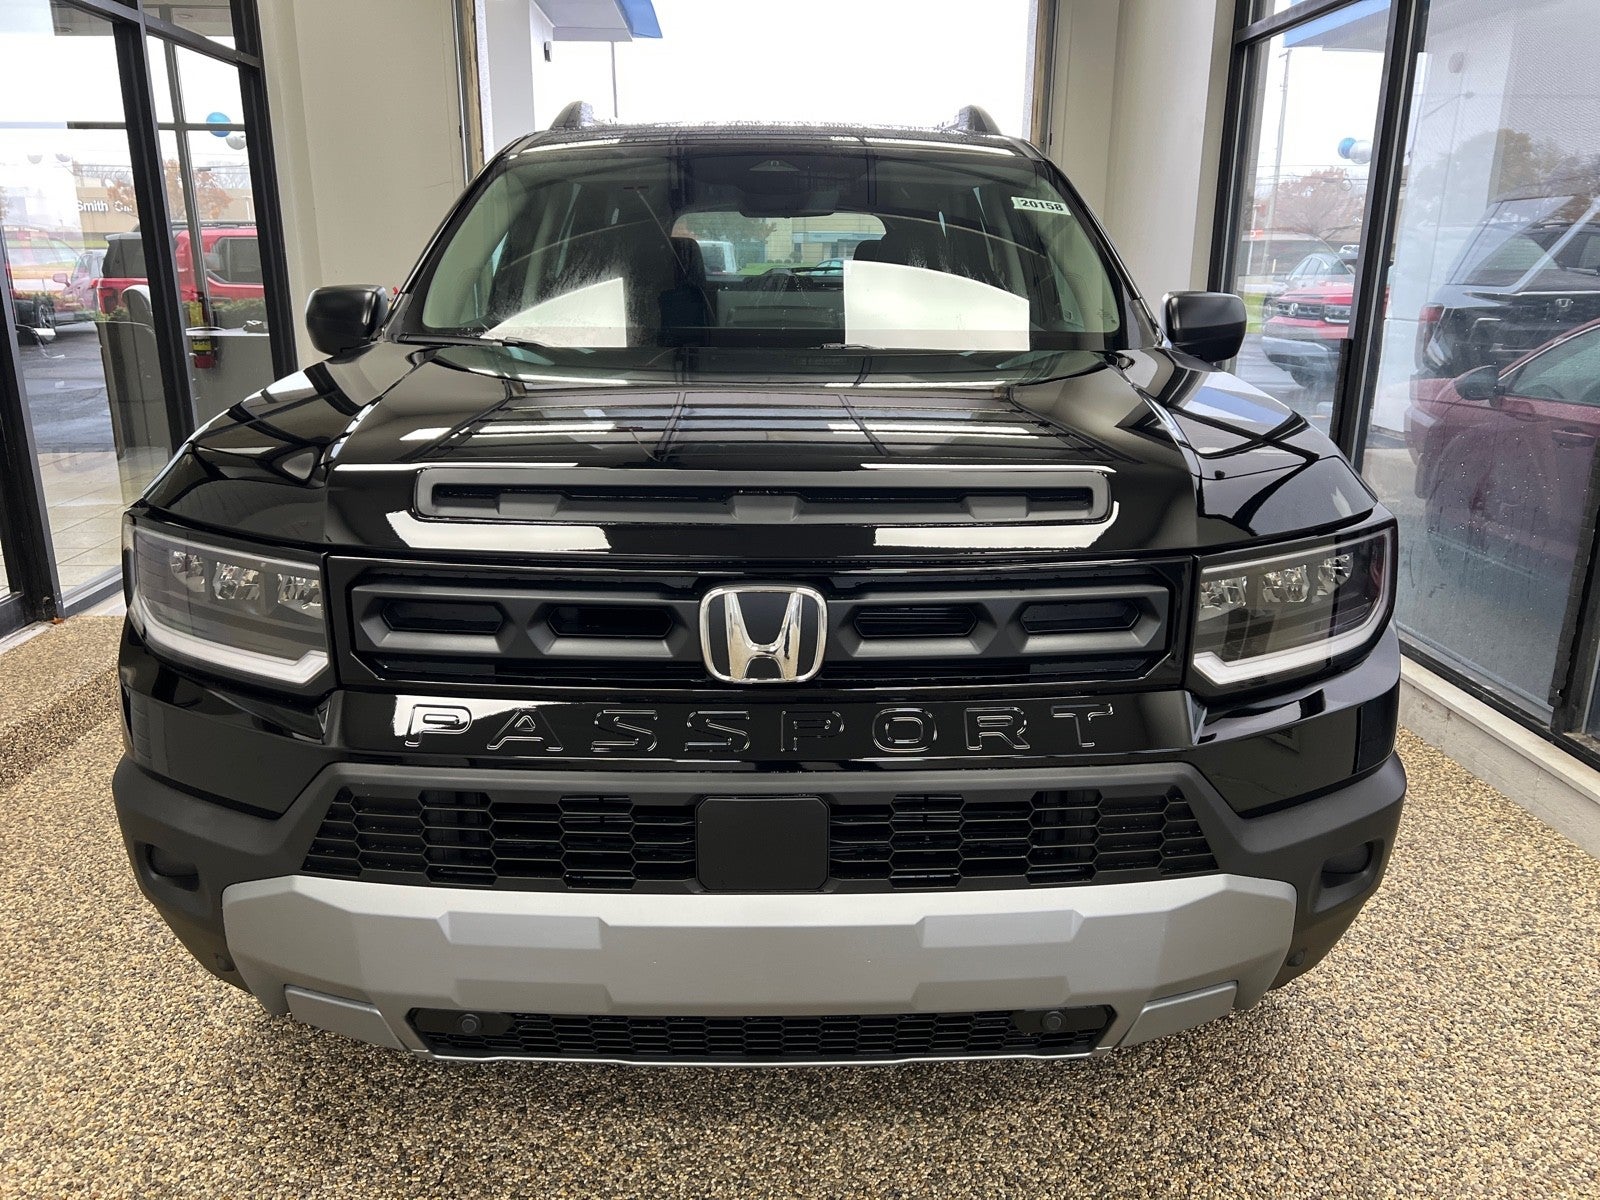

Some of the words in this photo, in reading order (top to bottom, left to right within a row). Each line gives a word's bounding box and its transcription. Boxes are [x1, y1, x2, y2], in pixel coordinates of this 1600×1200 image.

[77, 200, 109, 212] Smith
[1020, 199, 1064, 211] 20158
[404, 703, 1113, 752] PASSPORT
